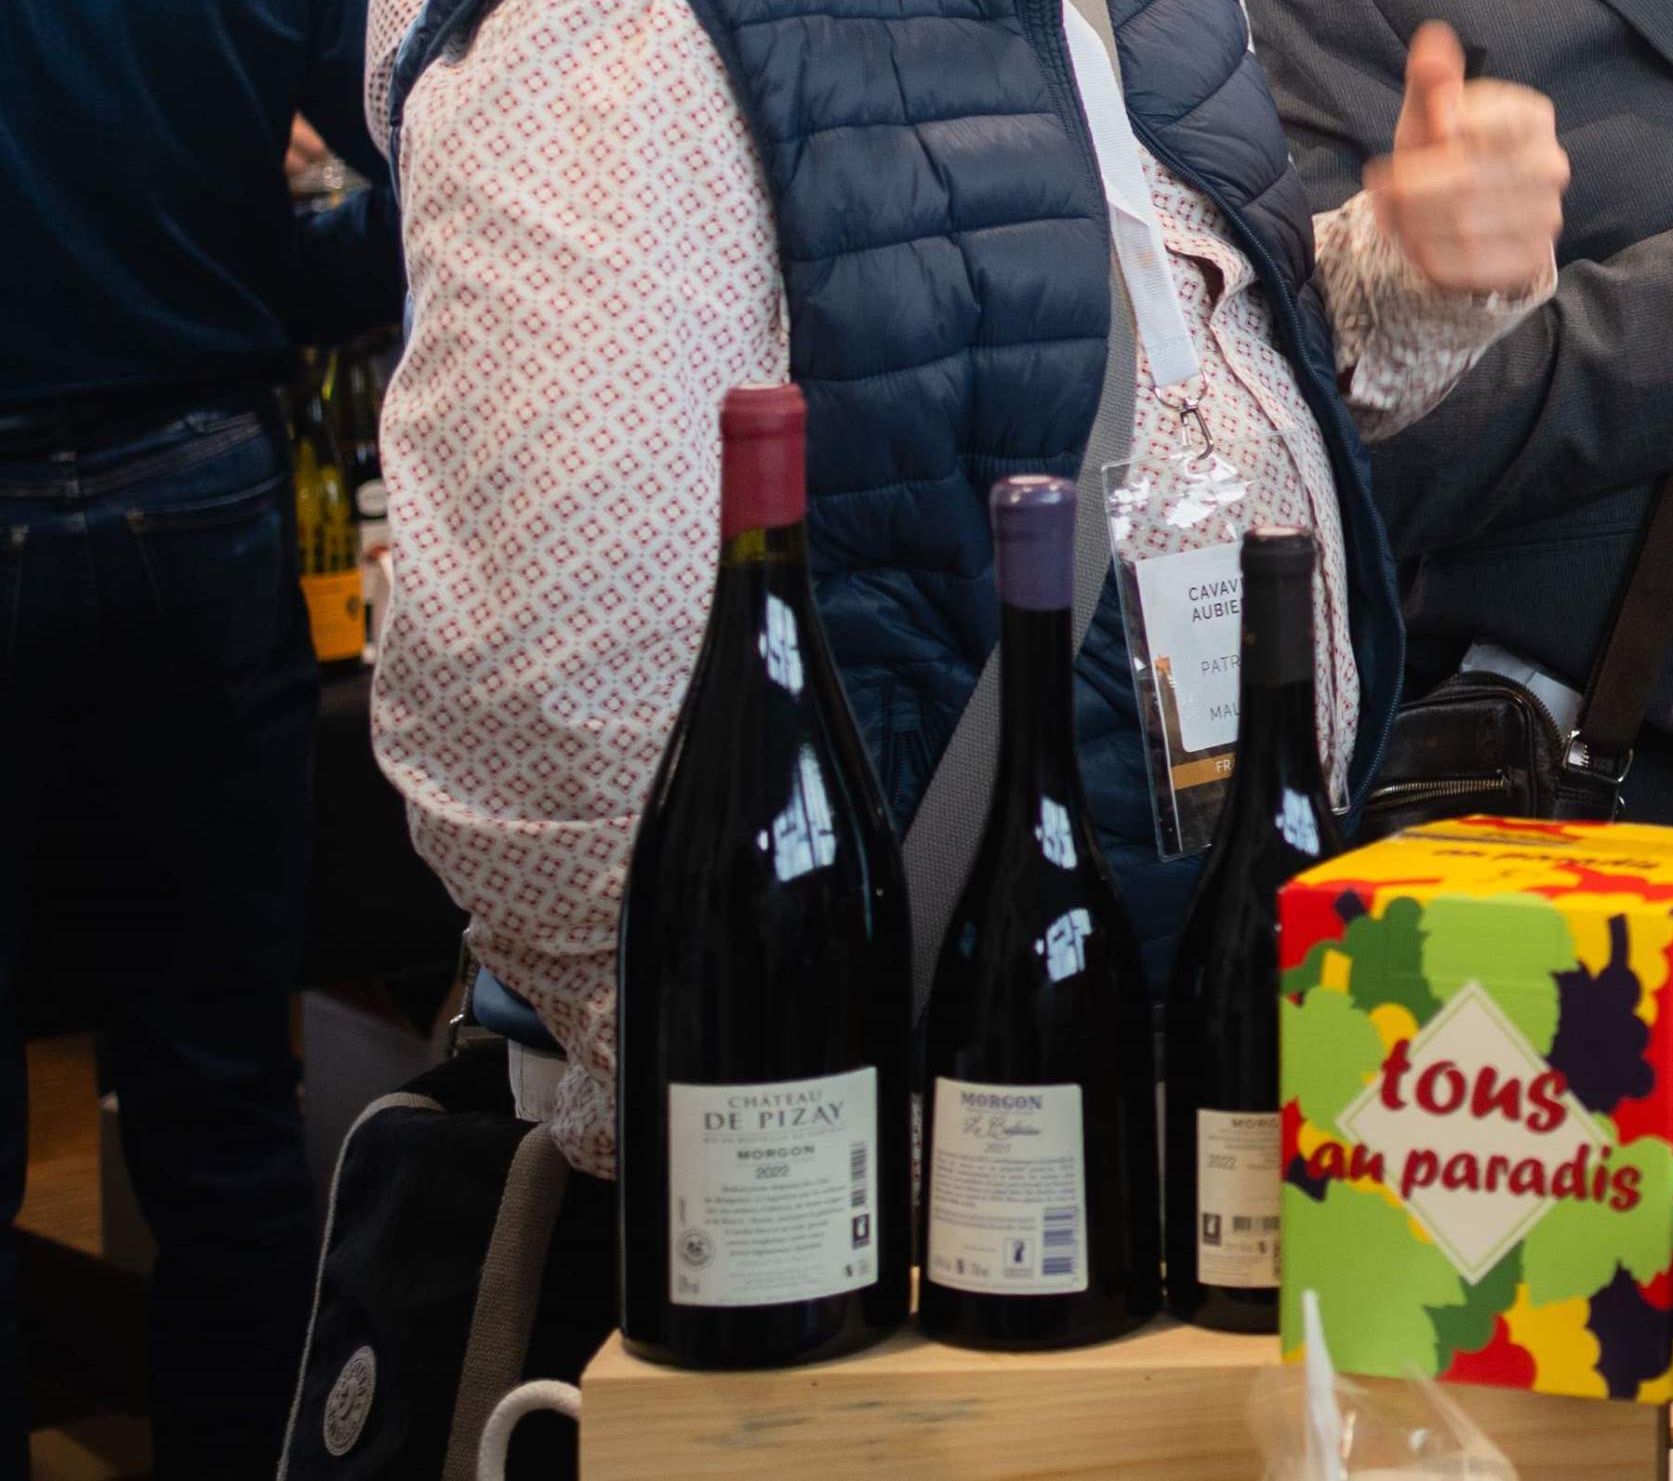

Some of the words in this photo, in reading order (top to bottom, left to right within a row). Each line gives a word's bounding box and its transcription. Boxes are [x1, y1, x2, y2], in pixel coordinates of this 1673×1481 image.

[1188, 578, 1243, 601] CAVAV
[1192, 599, 1241, 623] AUBIE
[1201, 654, 1240, 676] PATR
[1210, 704, 1240, 722] MAL
[1380, 1038, 1568, 1134] tous
[960, 1091, 1043, 1110] MORGON
[703, 1111, 745, 1131] DE
[759, 1101, 845, 1131] PIZAY
[1232, 1118, 1281, 1129] MORG
[736, 1144, 815, 1161] MORGON
[755, 1165, 790, 1180] 2022
[1304, 1141, 1384, 1184] au
[1400, 1142, 1642, 1212] paradis
